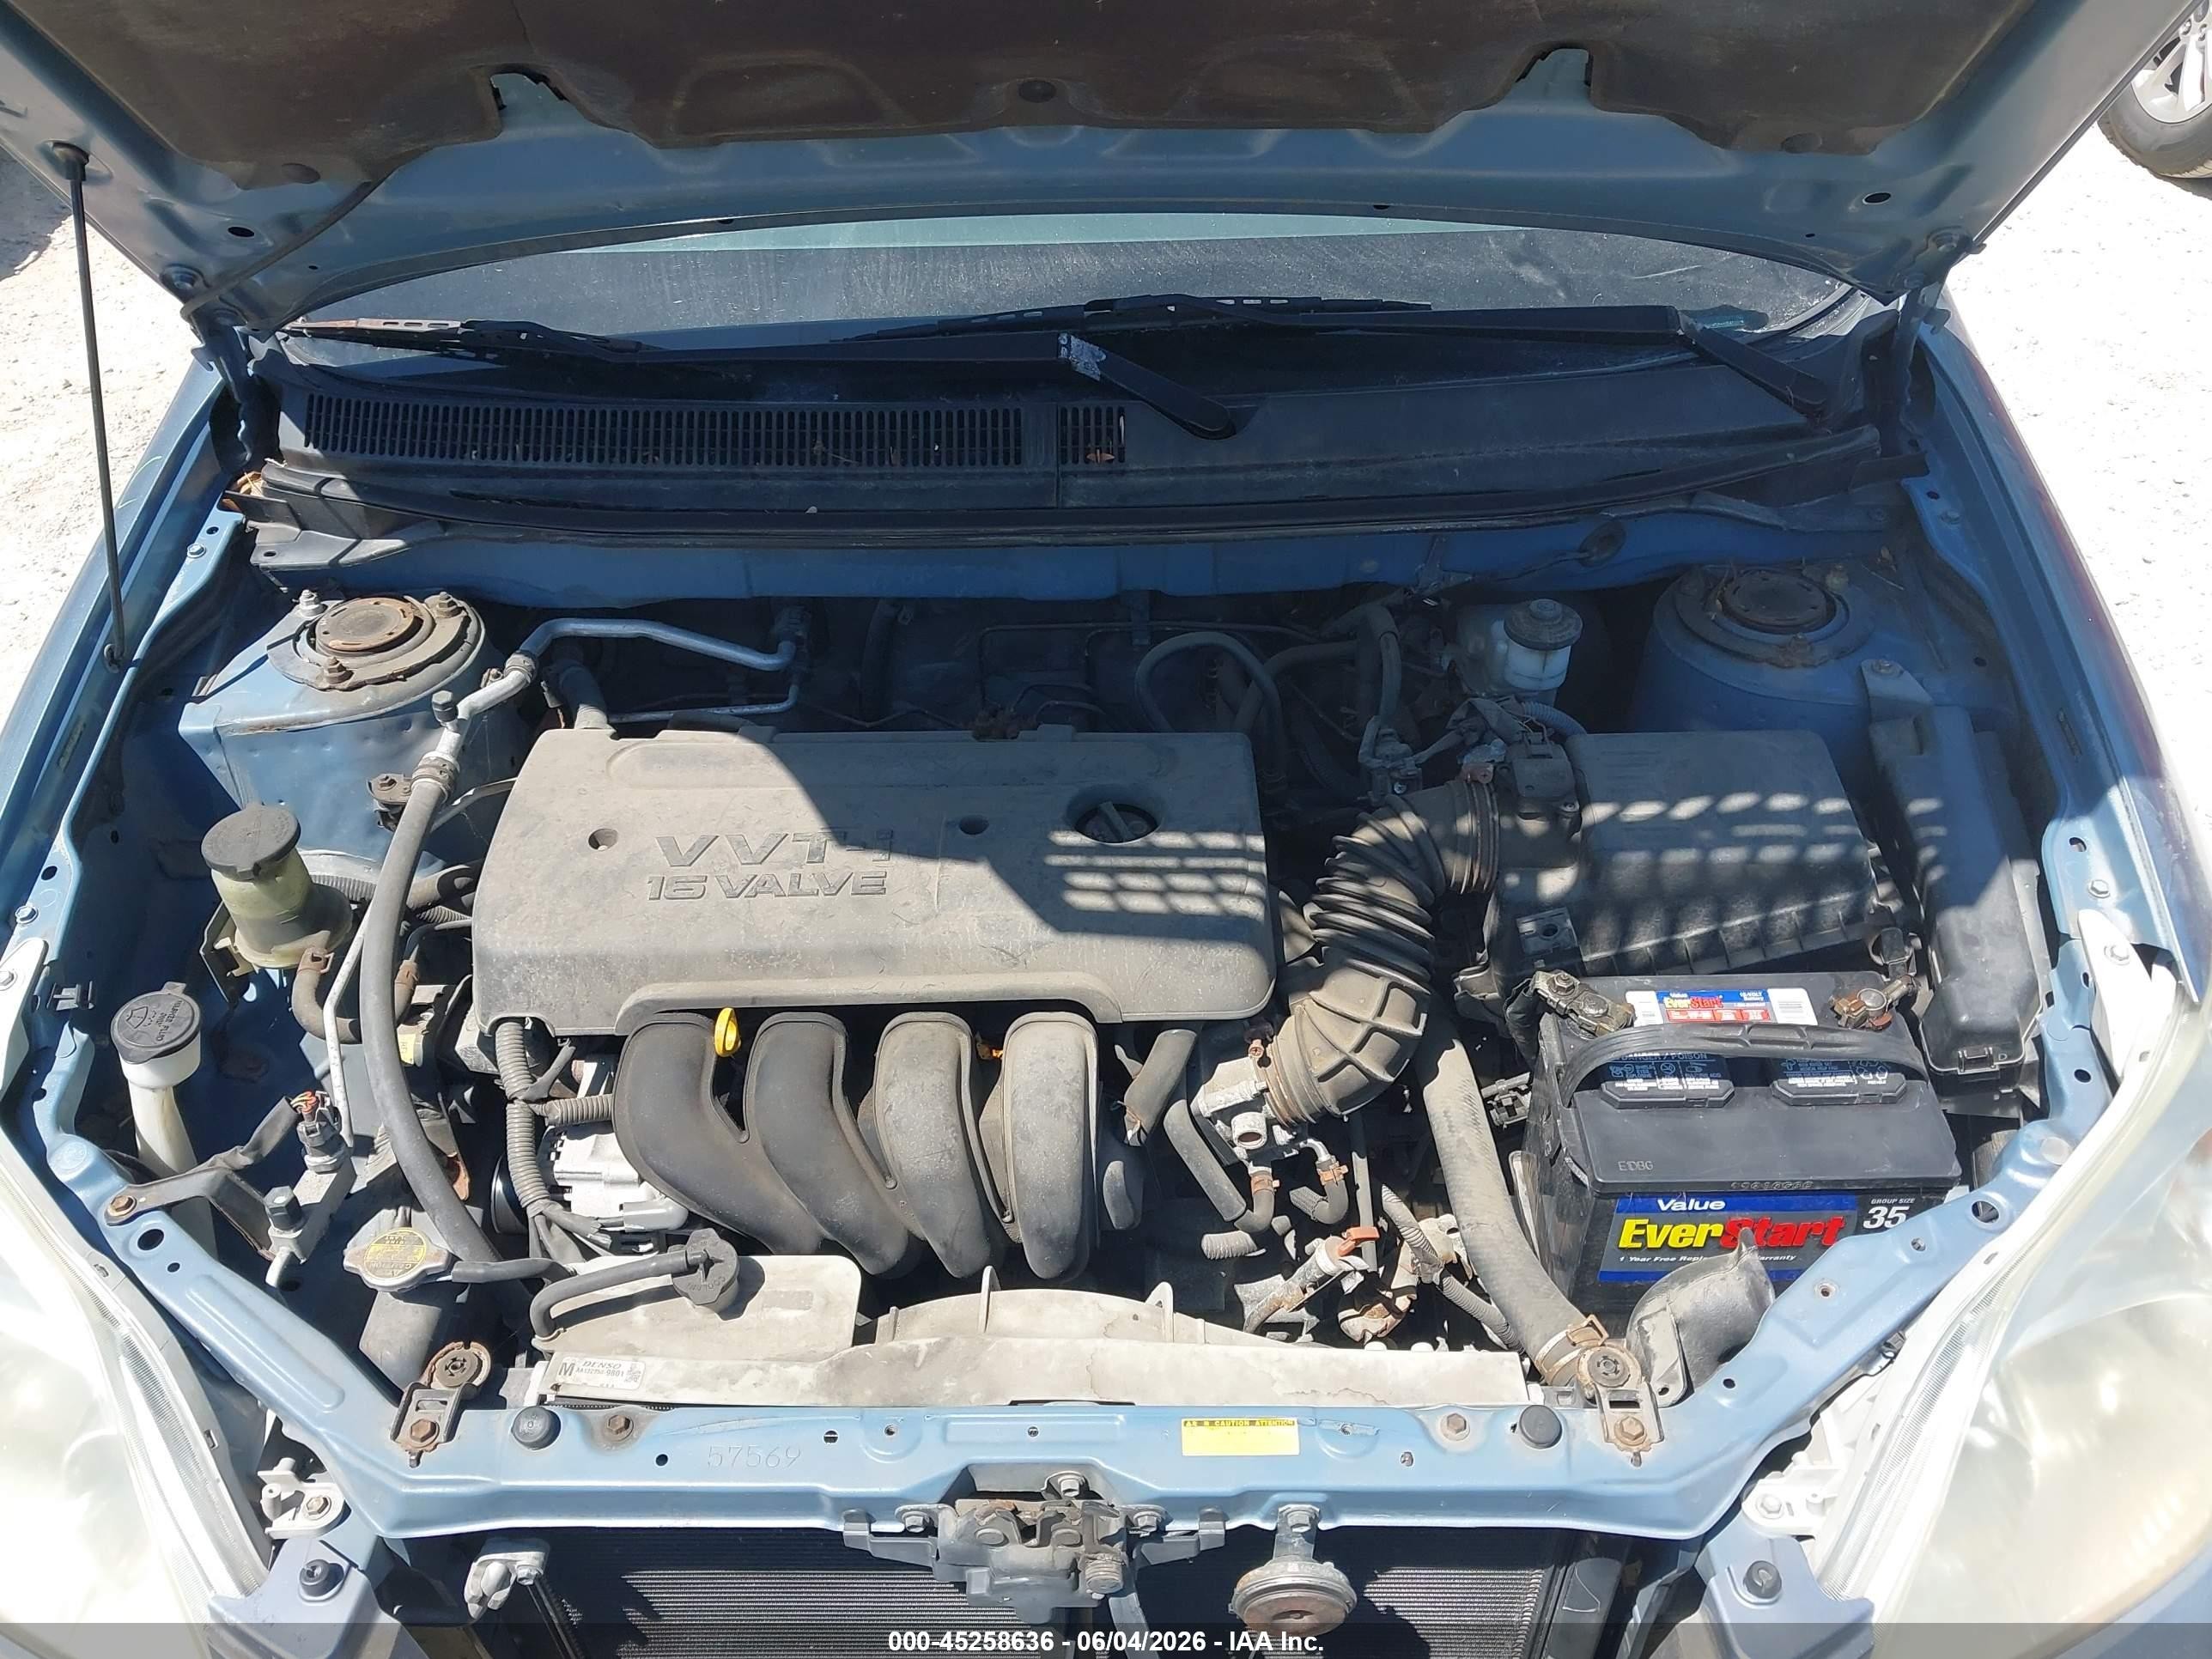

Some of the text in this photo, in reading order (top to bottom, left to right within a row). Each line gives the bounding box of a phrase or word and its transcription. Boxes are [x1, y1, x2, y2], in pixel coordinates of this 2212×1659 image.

[647, 870, 888, 900] 16 VALVE
[1657, 1199, 1726, 1211] Value
[1863, 1206, 1911, 1229] 35
[1618, 1216, 1845, 1249] EverStart
[558, 1362, 575, 1376] M
[582, 1361, 623, 1370] DENSO
[707, 1443, 801, 1469] 57569
